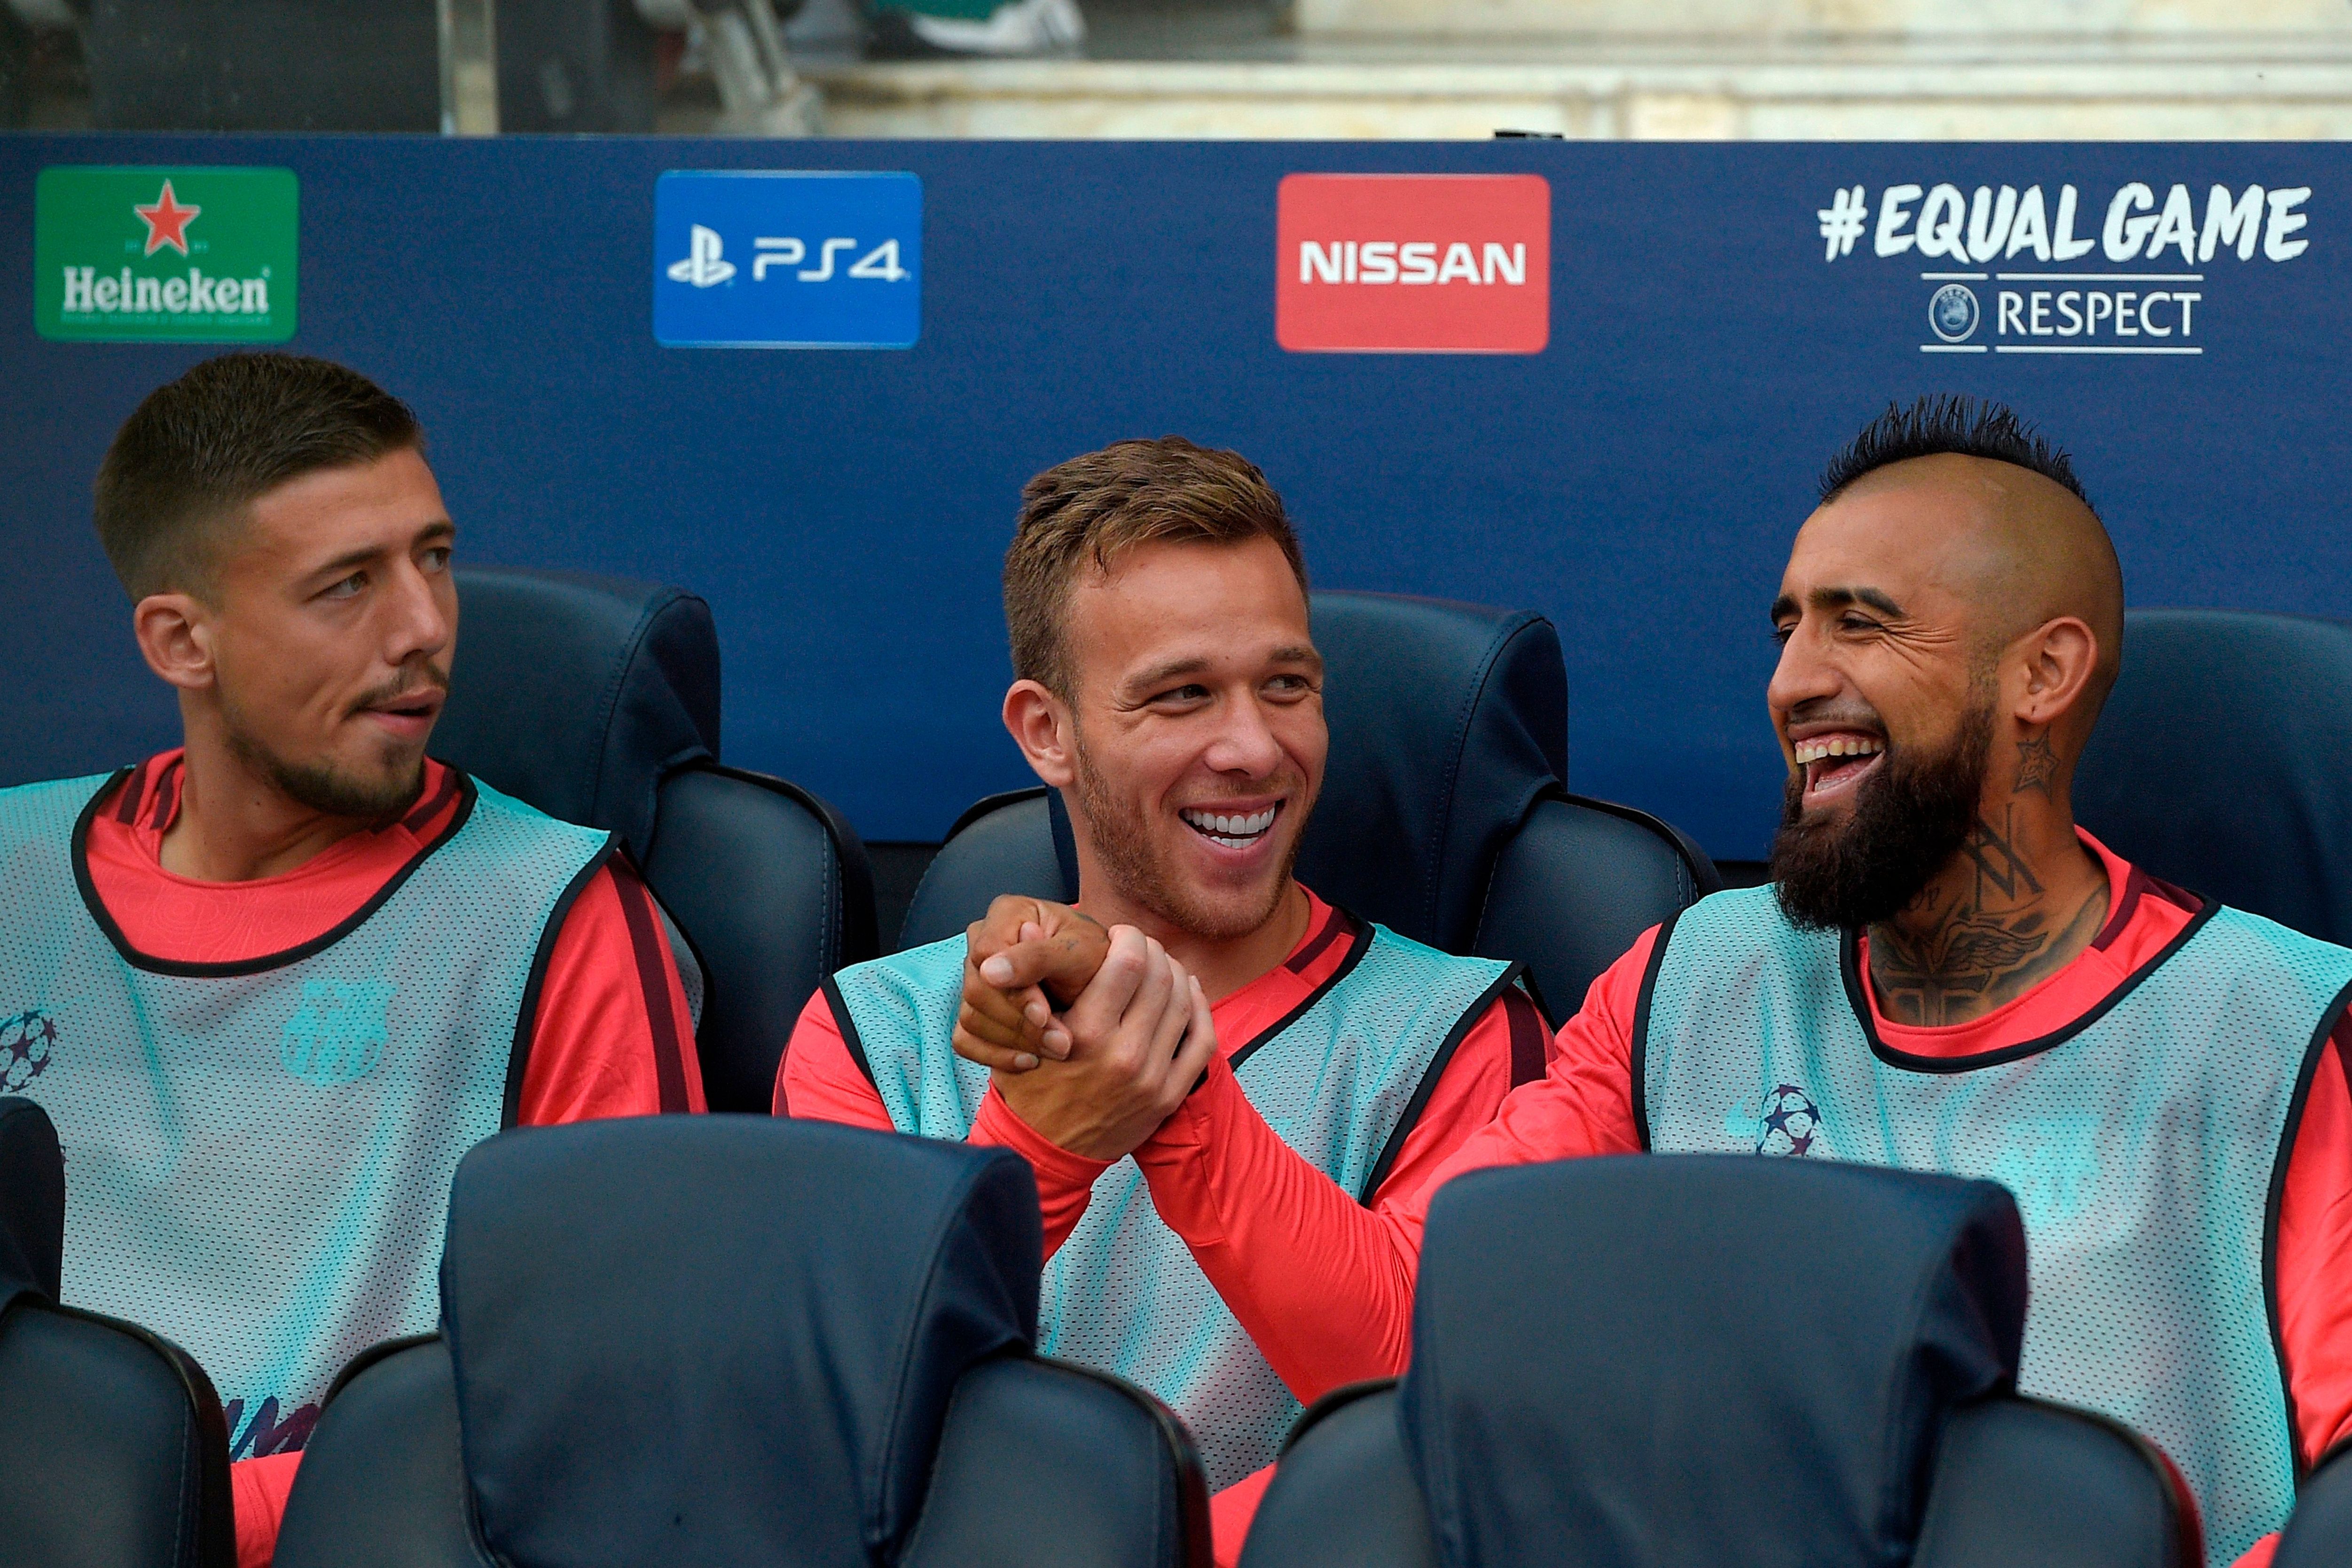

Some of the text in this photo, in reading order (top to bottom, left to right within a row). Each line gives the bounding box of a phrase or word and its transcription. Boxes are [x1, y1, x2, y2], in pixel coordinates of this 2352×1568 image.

[753, 237, 906, 282] PS4
[1299, 240, 1527, 286] NISSAN
[63, 266, 269, 314] Heineken
[1998, 290, 2202, 337] RESPECT
